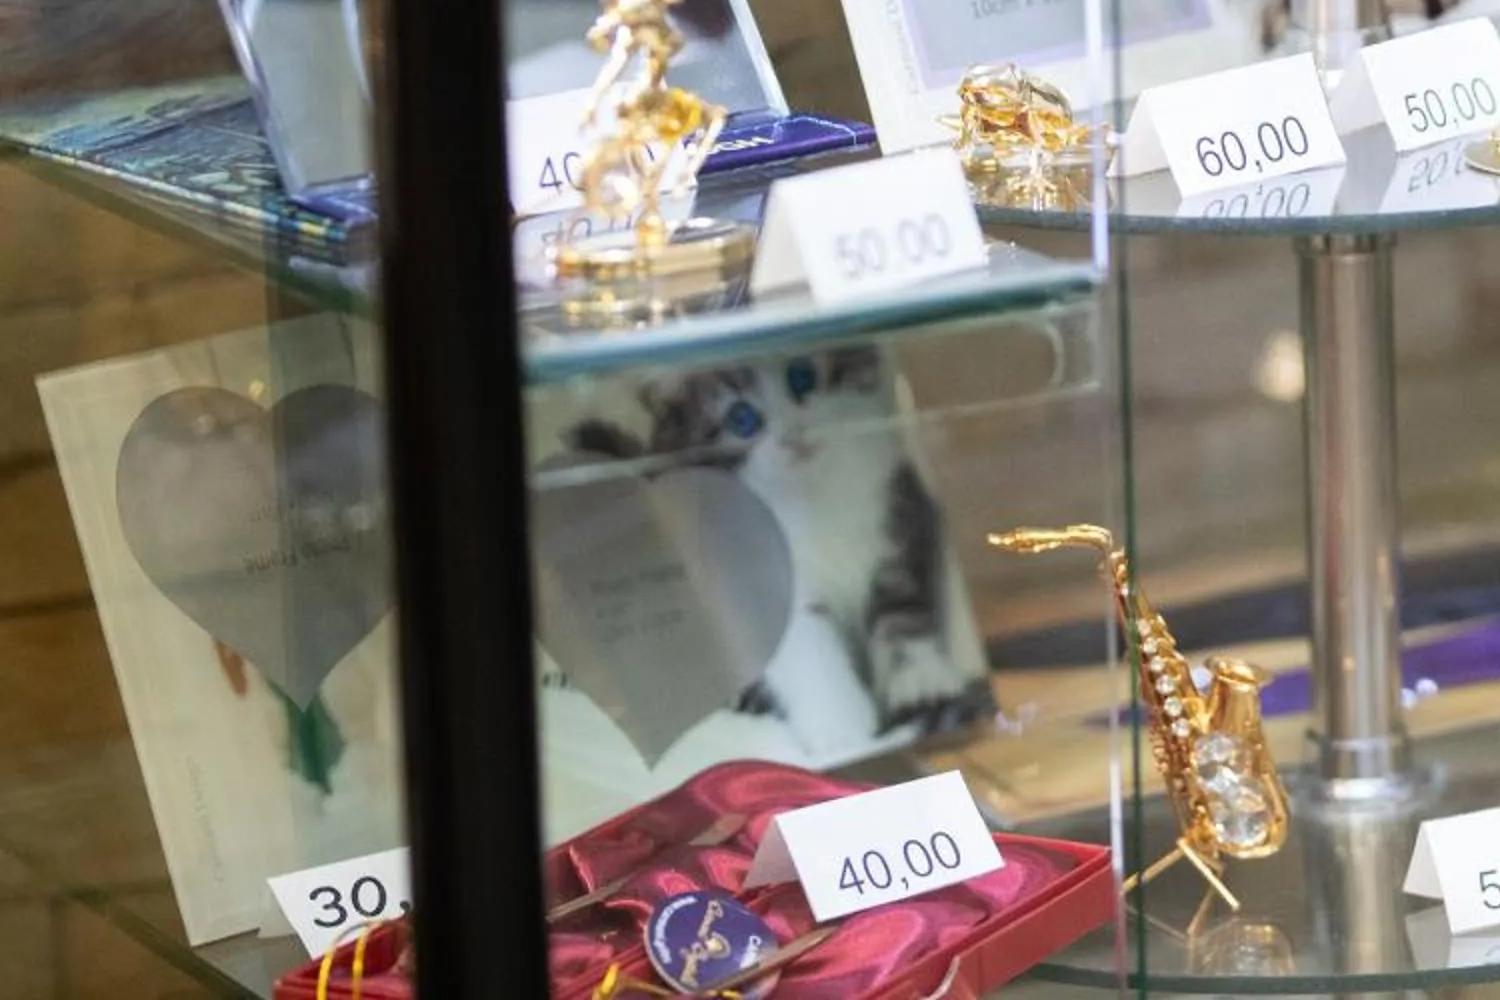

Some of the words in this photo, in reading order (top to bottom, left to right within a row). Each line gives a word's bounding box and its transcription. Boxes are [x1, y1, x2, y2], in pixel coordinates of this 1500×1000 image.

[1403, 77, 1497, 133] 50,00
[1196, 115, 1311, 179] 60,00
[834, 212, 954, 281] 50,00
[839, 831, 961, 895] 40,00
[309, 876, 411, 928] 30,
